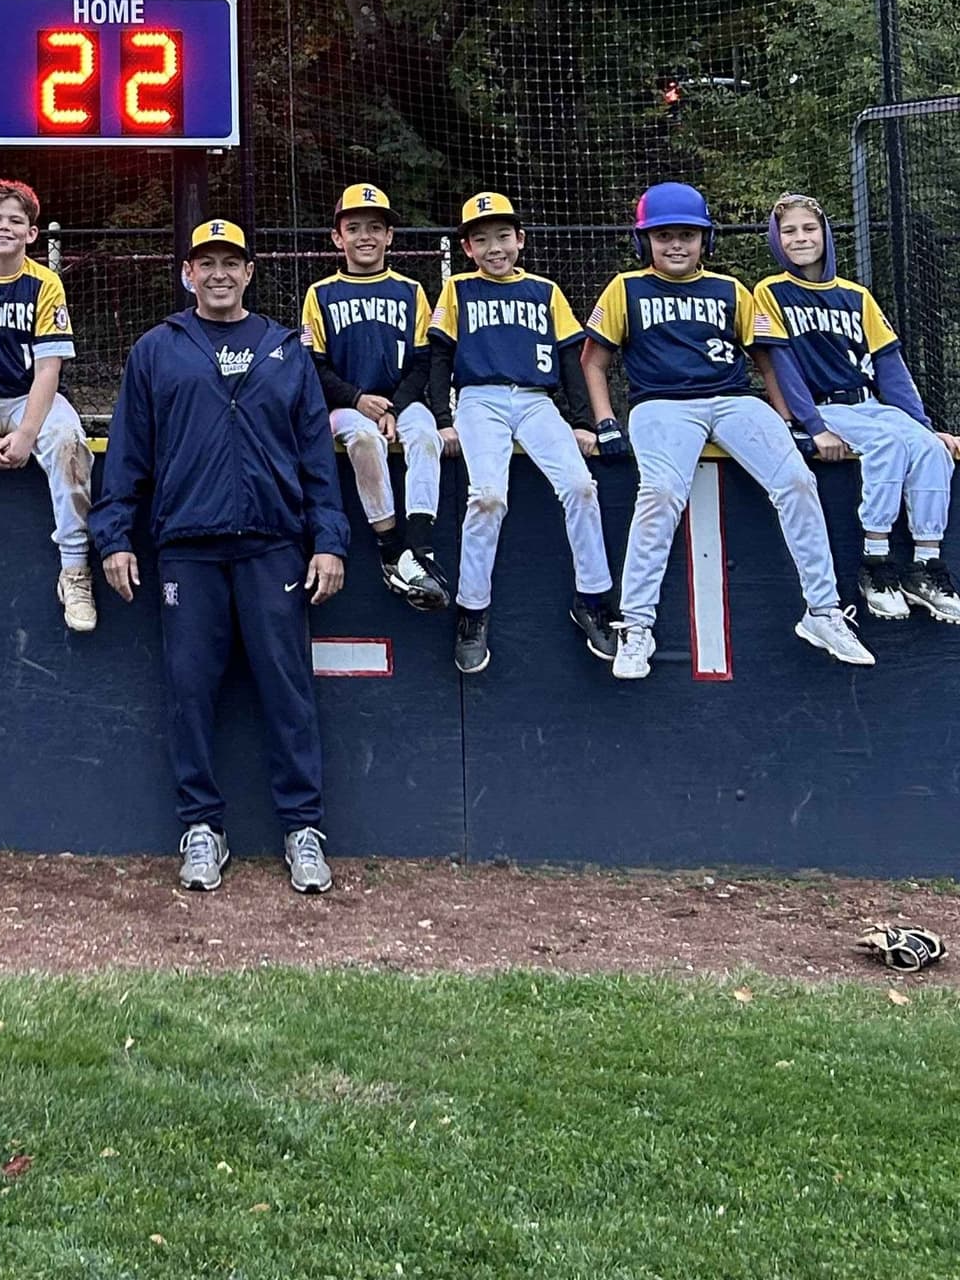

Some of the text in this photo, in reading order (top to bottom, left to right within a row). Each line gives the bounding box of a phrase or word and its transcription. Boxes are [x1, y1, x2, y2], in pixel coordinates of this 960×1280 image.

[73, 0, 145, 24] HOME
[42, 32, 178, 124] 22
[362, 187, 377, 203] E
[476, 196, 492, 213] E
[209, 222, 226, 237] E
[328, 296, 407, 336] BREWERS
[466, 300, 548, 336] BREWERS
[640, 297, 727, 330] BREWERS
[536, 343, 553, 374] 5
